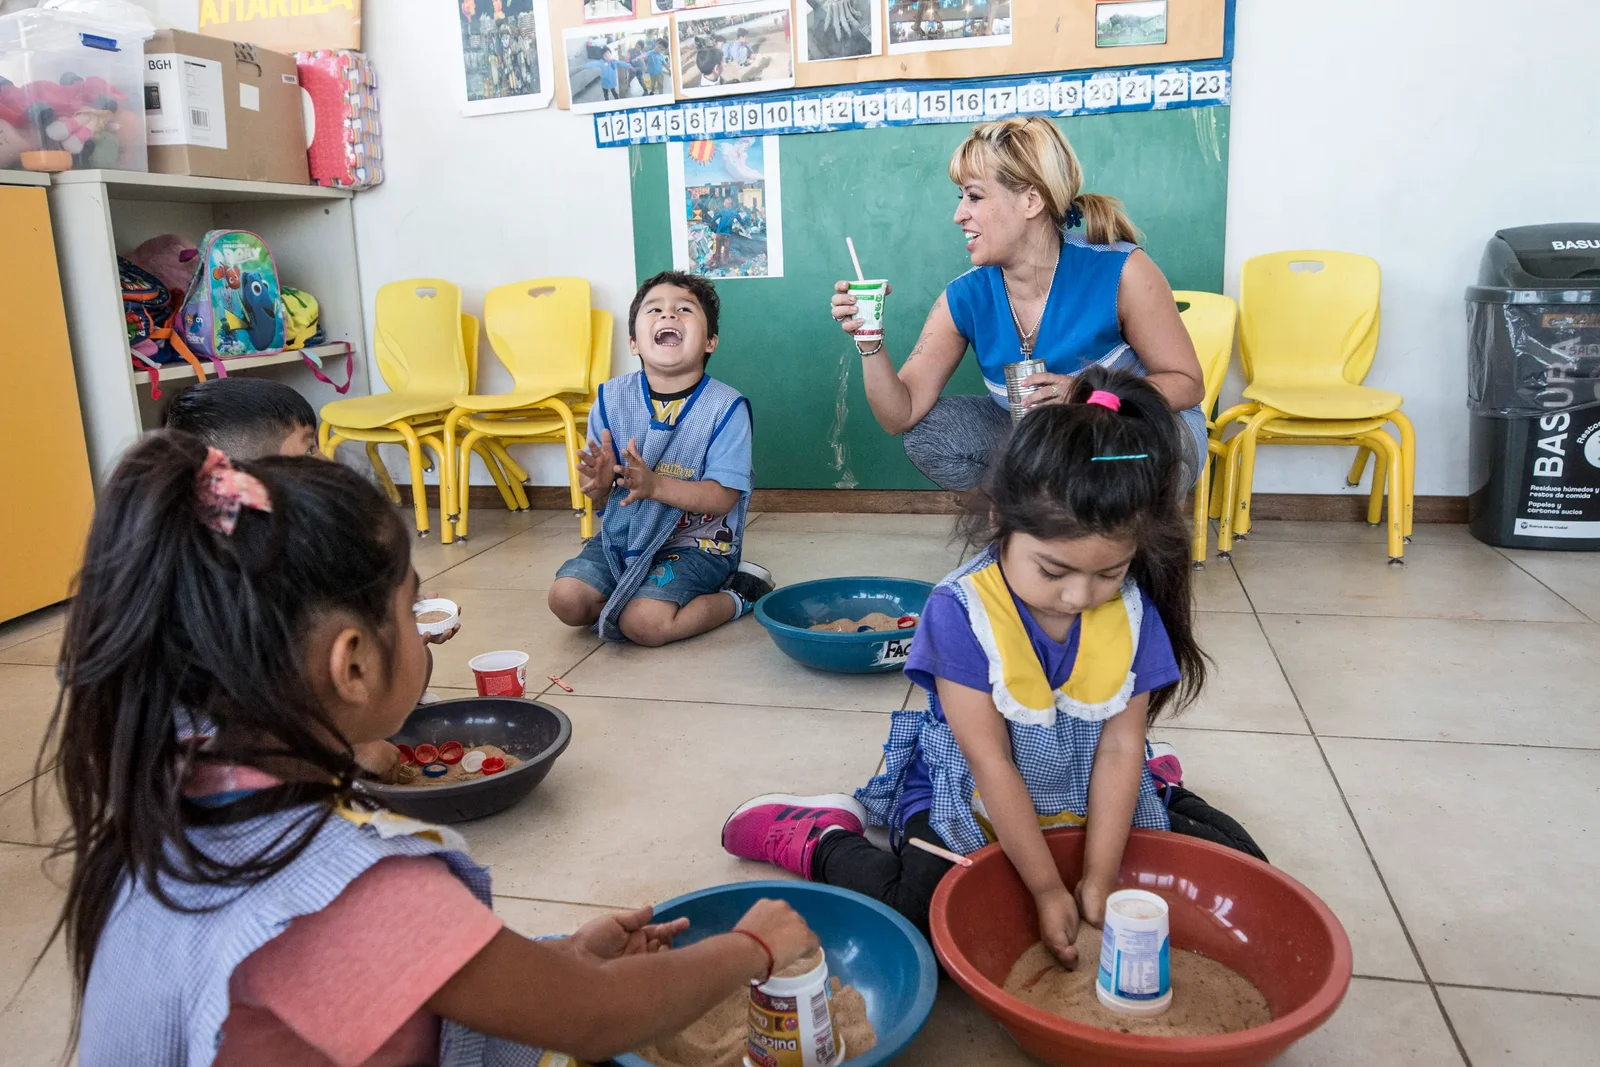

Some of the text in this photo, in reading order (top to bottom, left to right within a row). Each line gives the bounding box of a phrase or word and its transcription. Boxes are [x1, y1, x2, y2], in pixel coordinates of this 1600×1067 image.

[148, 60, 172, 70] BGH
[602, 76, 1221, 137] 1 2 3 4 5 6 7 8 9 10 11 12 13 14 15 16 17 18 19 20 21 22 23
[1551, 239, 1600, 250] BASU
[1533, 336, 1581, 477] BASURA
[1530, 484, 1561, 492] Residuos
[761, 1035, 797, 1051] Dulce
